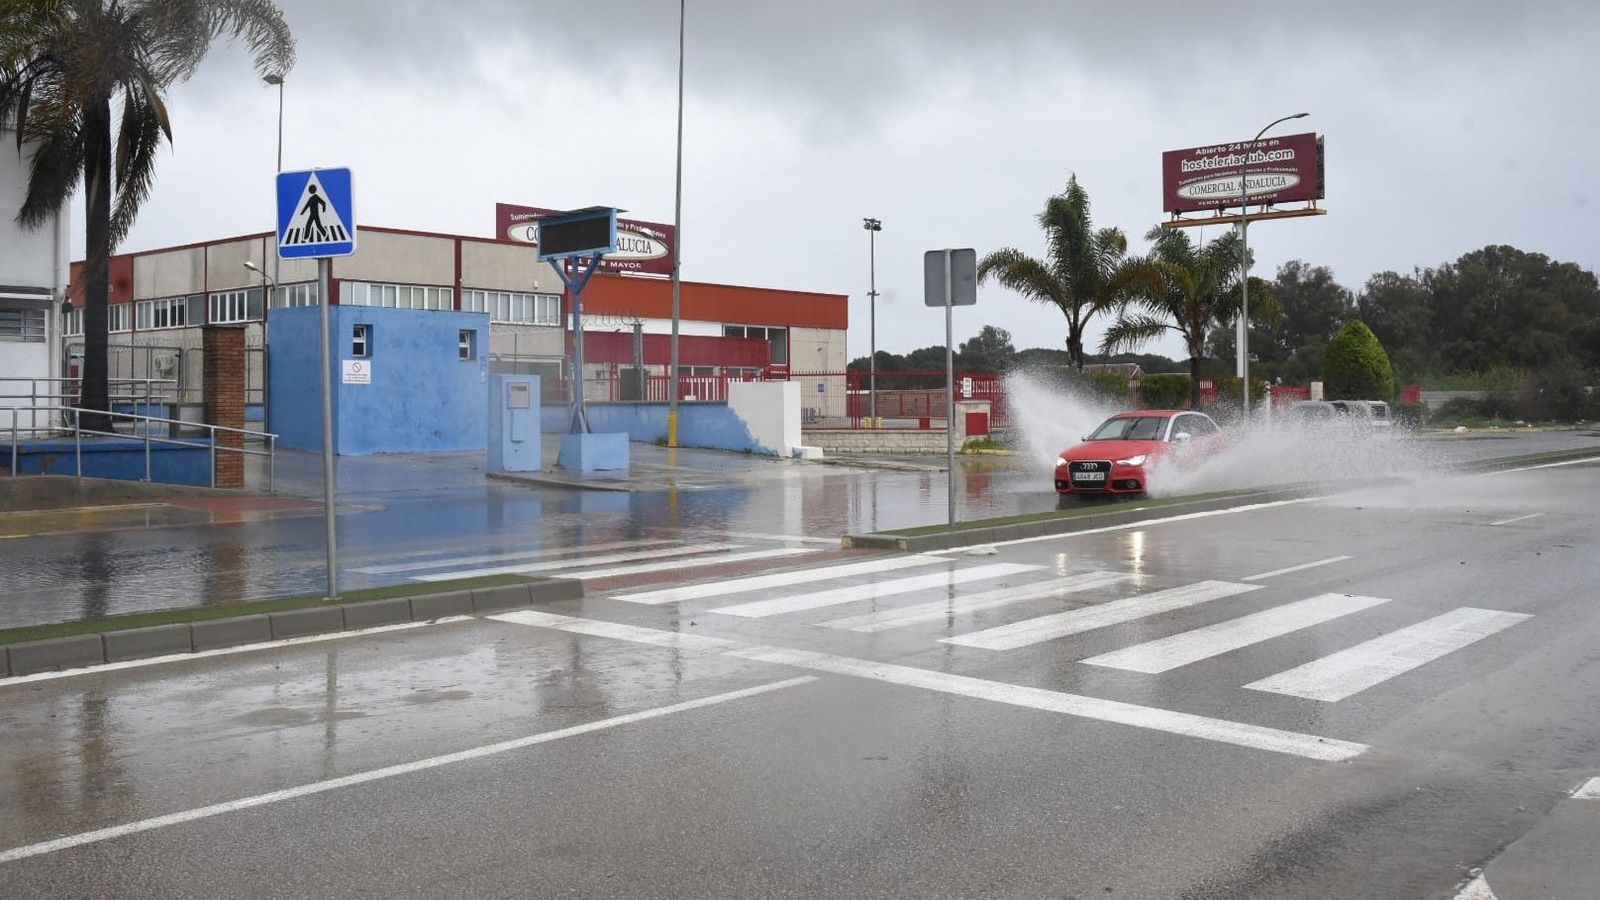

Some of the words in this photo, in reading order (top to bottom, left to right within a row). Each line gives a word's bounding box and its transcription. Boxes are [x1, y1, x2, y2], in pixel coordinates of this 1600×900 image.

[1196, 146, 1226, 154] Abierto
[1229, 143, 1241, 152] 24
[1189, 182, 1236, 195] COMERCIAL
[1251, 193, 1278, 201] MAYOR
[616, 236, 652, 255] ALUCIA
